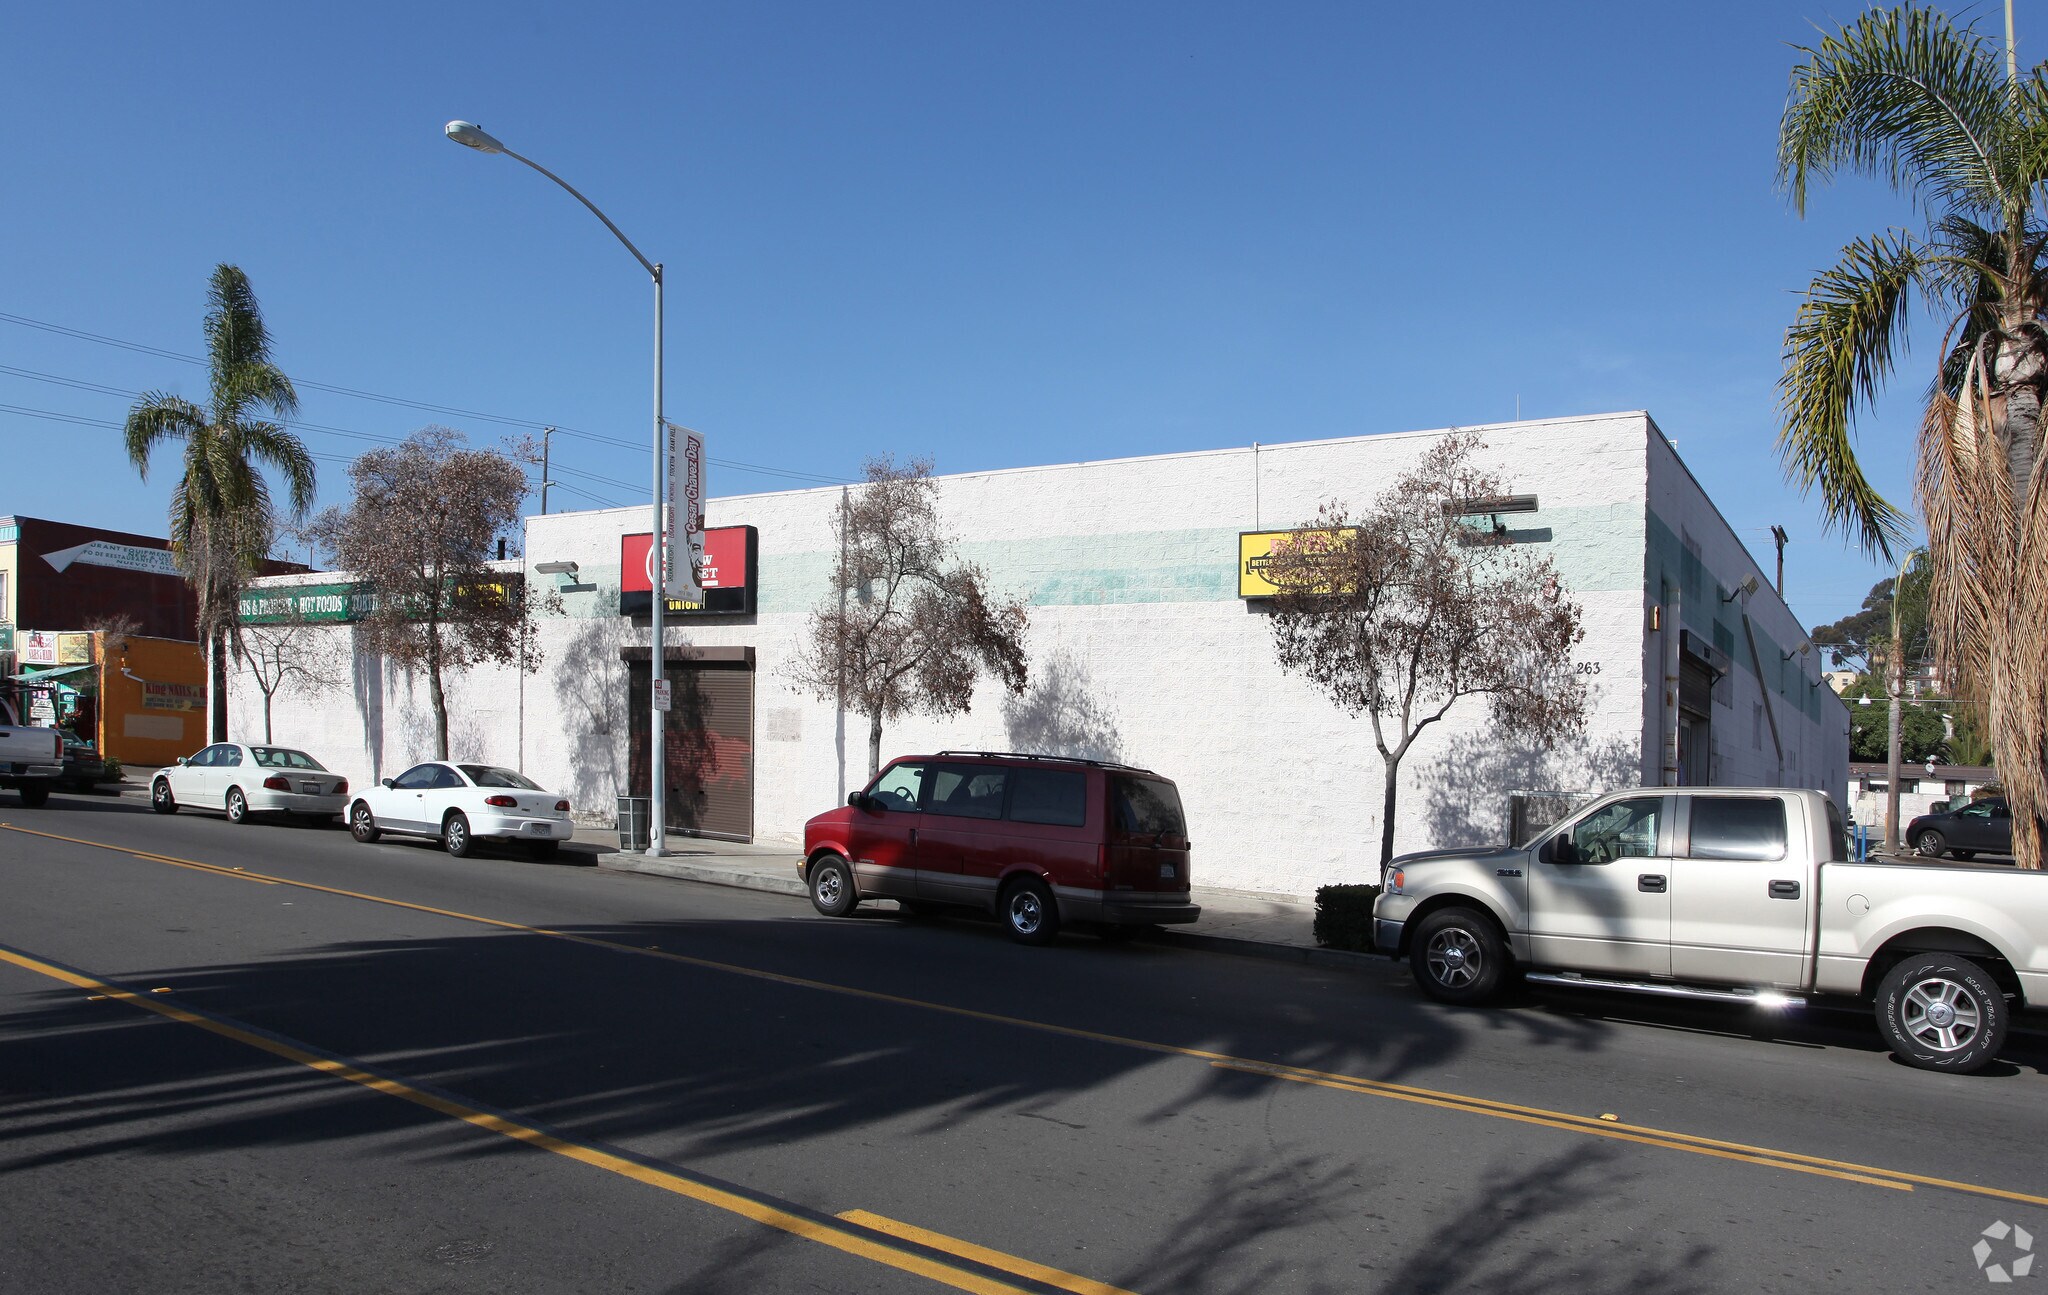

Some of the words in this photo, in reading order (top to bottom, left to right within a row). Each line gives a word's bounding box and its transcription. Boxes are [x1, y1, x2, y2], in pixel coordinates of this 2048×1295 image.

[685, 435, 701, 459] Day
[685, 457, 699, 500] Chavez
[685, 498, 699, 534] Cesar
[668, 523, 676, 539] LOGAN
[105, 553, 152, 564] RESTAURANTE
[123, 545, 172, 557] EQUIPMENT
[116, 559, 149, 568] NUEVO
[252, 600, 258, 615] &
[299, 595, 315, 612] HOT
[316, 595, 343, 612] FOODS
[668, 600, 698, 610] UNION
[28, 634, 44, 648] KING
[1576, 661, 1601, 675] 263
[145, 682, 167, 697] King
[168, 684, 192, 698] NAILS
[1965, 976, 1987, 996] MAX
